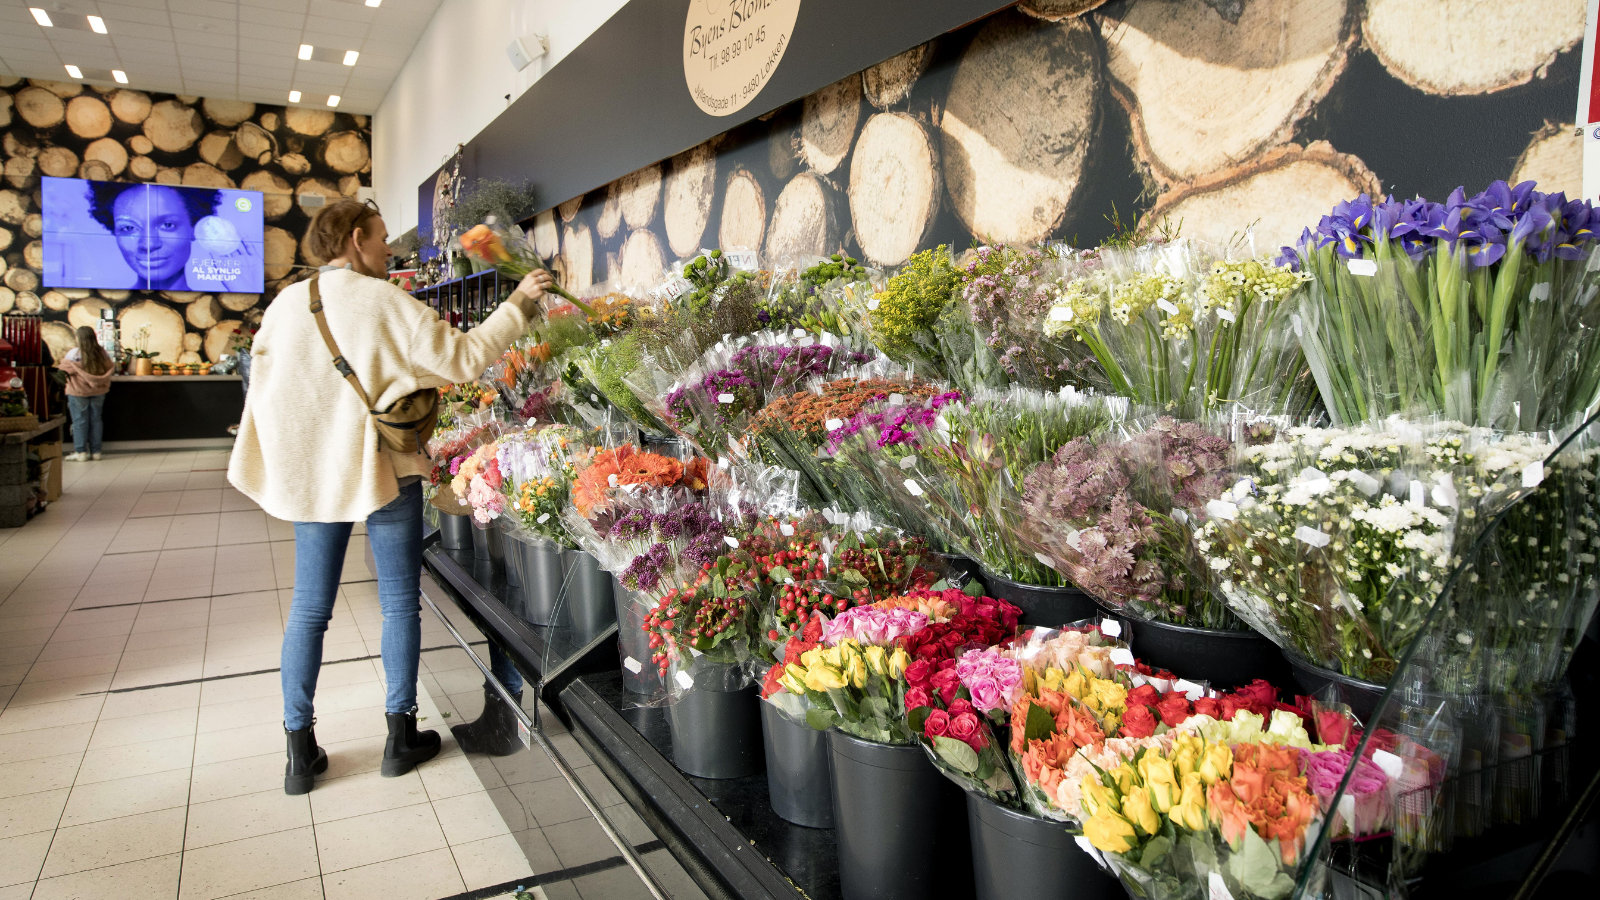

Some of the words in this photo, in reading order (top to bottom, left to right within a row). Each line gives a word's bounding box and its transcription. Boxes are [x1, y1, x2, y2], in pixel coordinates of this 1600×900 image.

[690, 18, 725, 59] Byens
[721, 46, 731, 66] 98
[732, 39, 742, 59] 99
[744, 32, 754, 51] 10
[755, 25, 766, 44] 45
[730, 92, 737, 107] 11
[742, 74, 760, 99] 9480
[760, 33, 786, 80] Løkken
[192, 258, 241, 267] FJERNER
[192, 266, 205, 274] AL
[207, 267, 241, 275] SYNLIG
